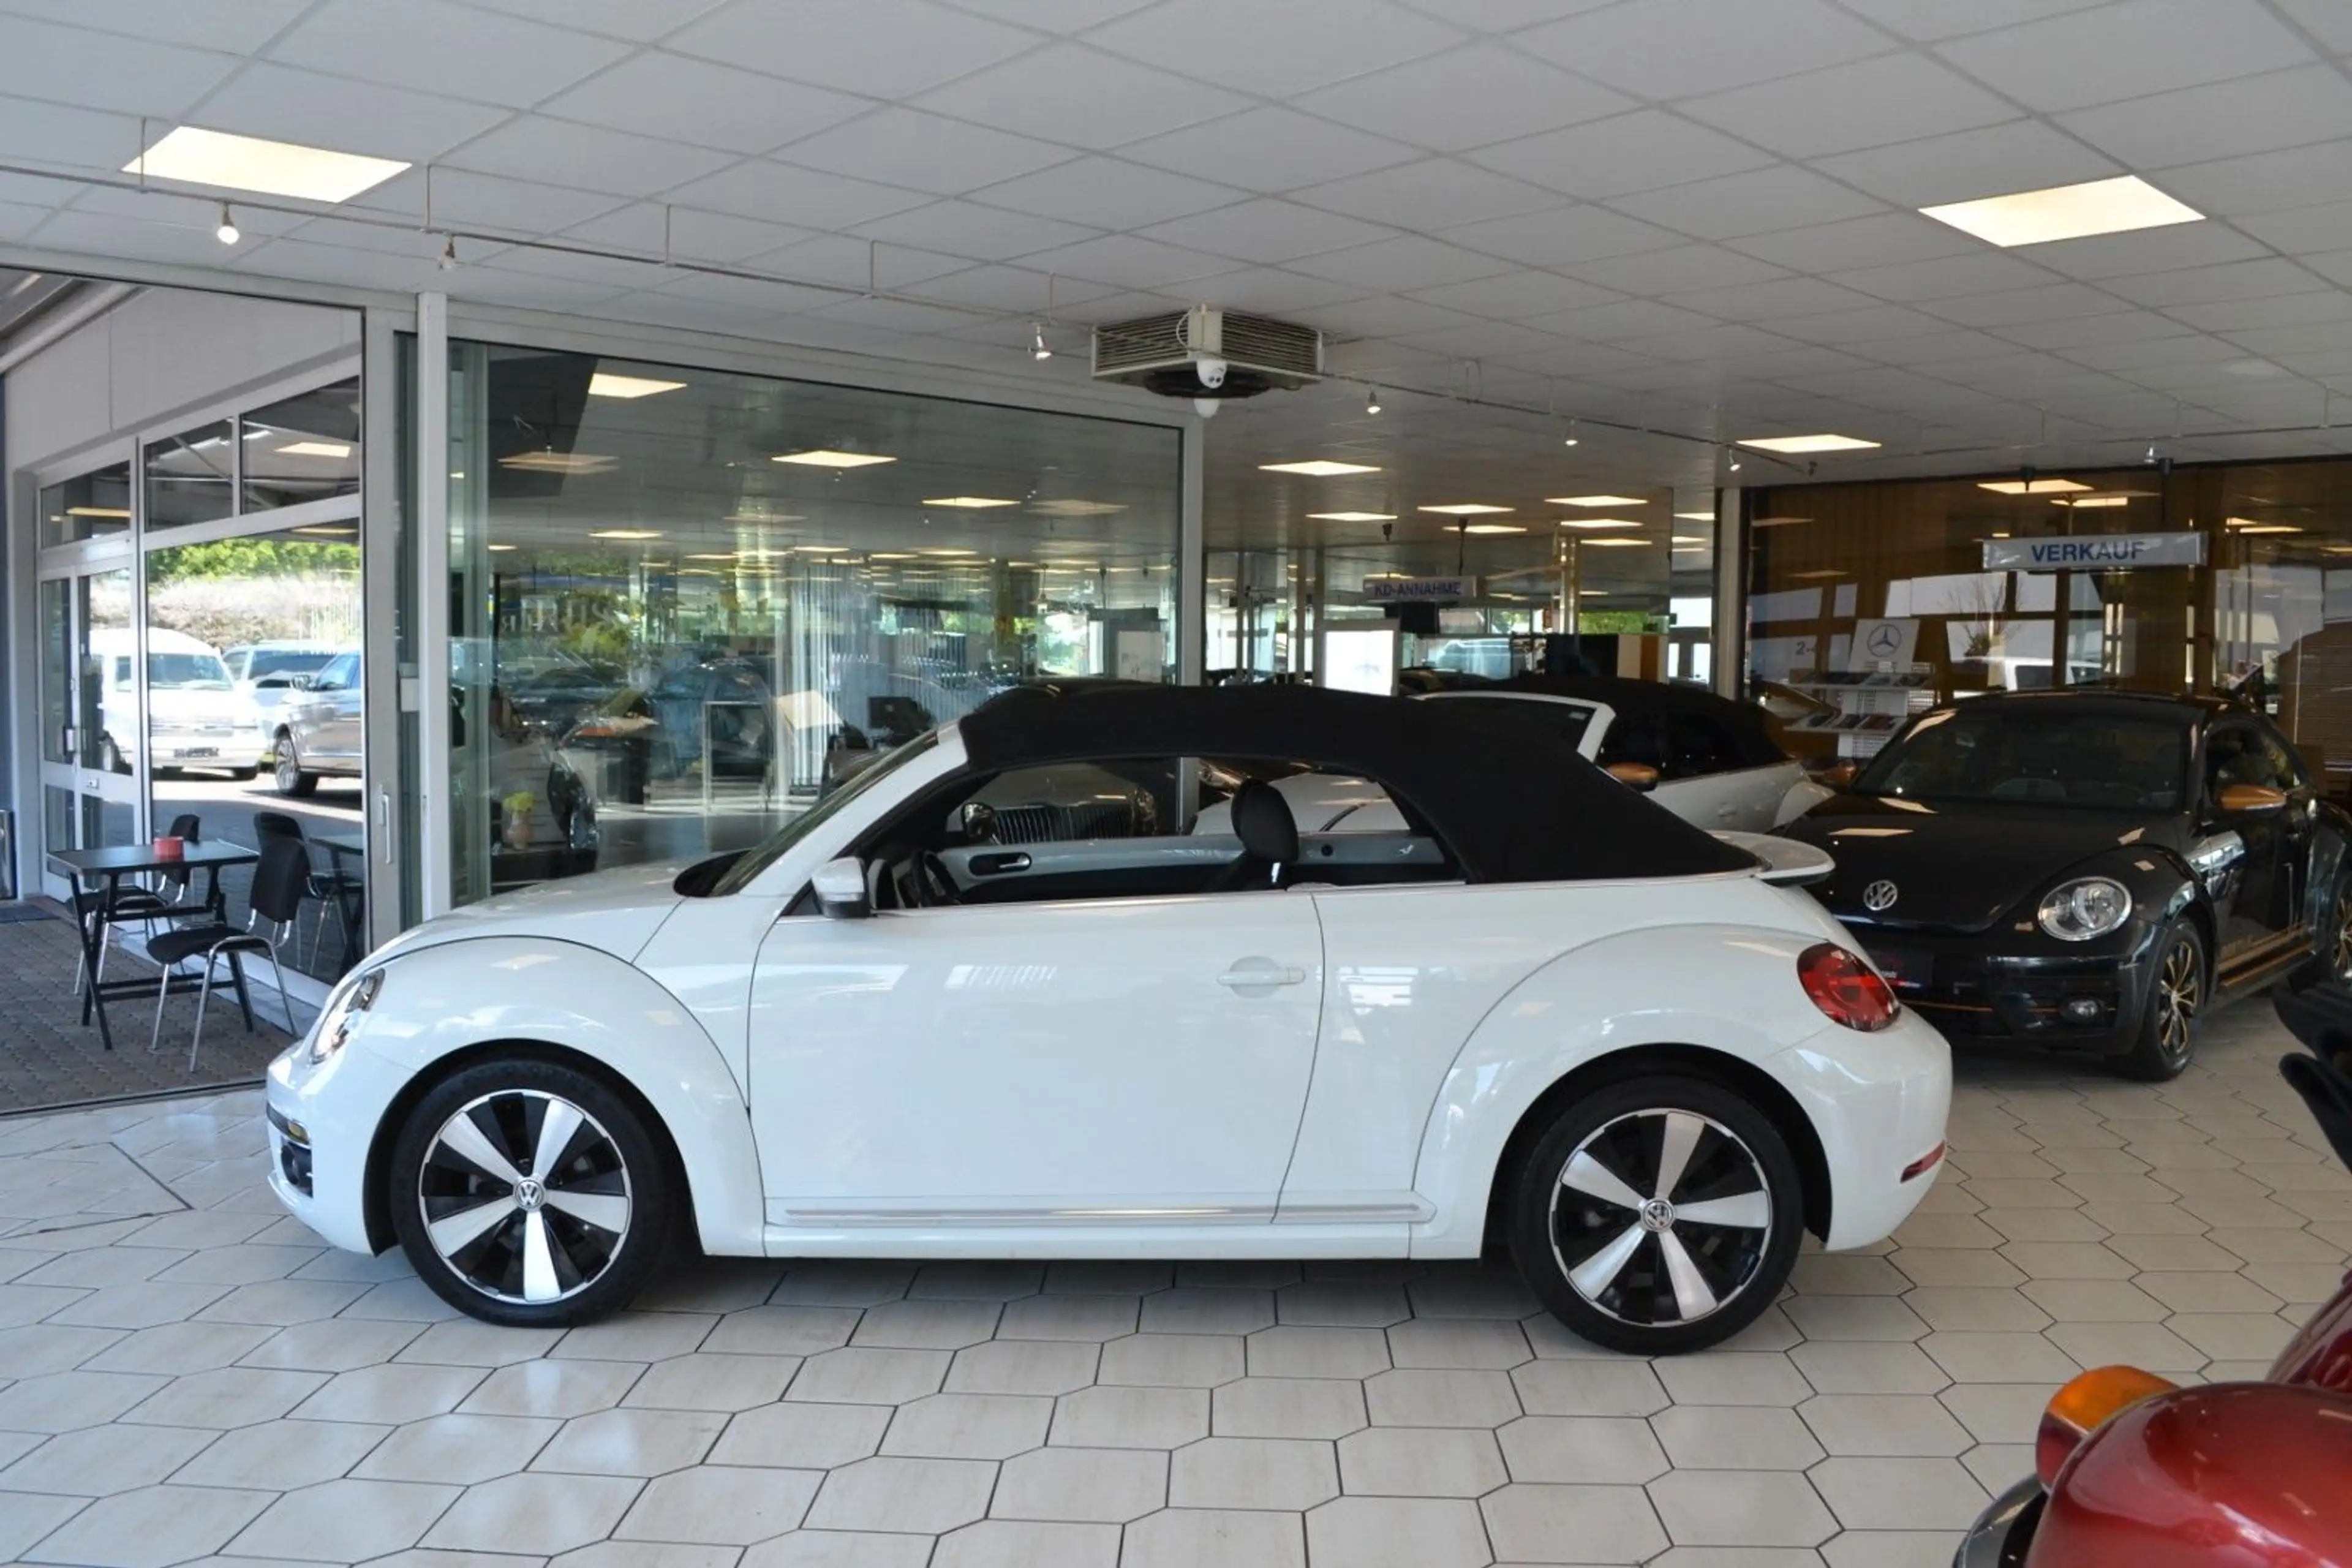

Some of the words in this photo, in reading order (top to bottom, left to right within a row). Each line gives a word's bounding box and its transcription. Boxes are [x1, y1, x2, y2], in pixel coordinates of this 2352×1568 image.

[2031, 541, 2146, 562] VERKAUF
[1374, 582, 1463, 596] KD-ANNAHME
[1863, 880, 1898, 911] VW
[515, 1179, 544, 1208] VW
